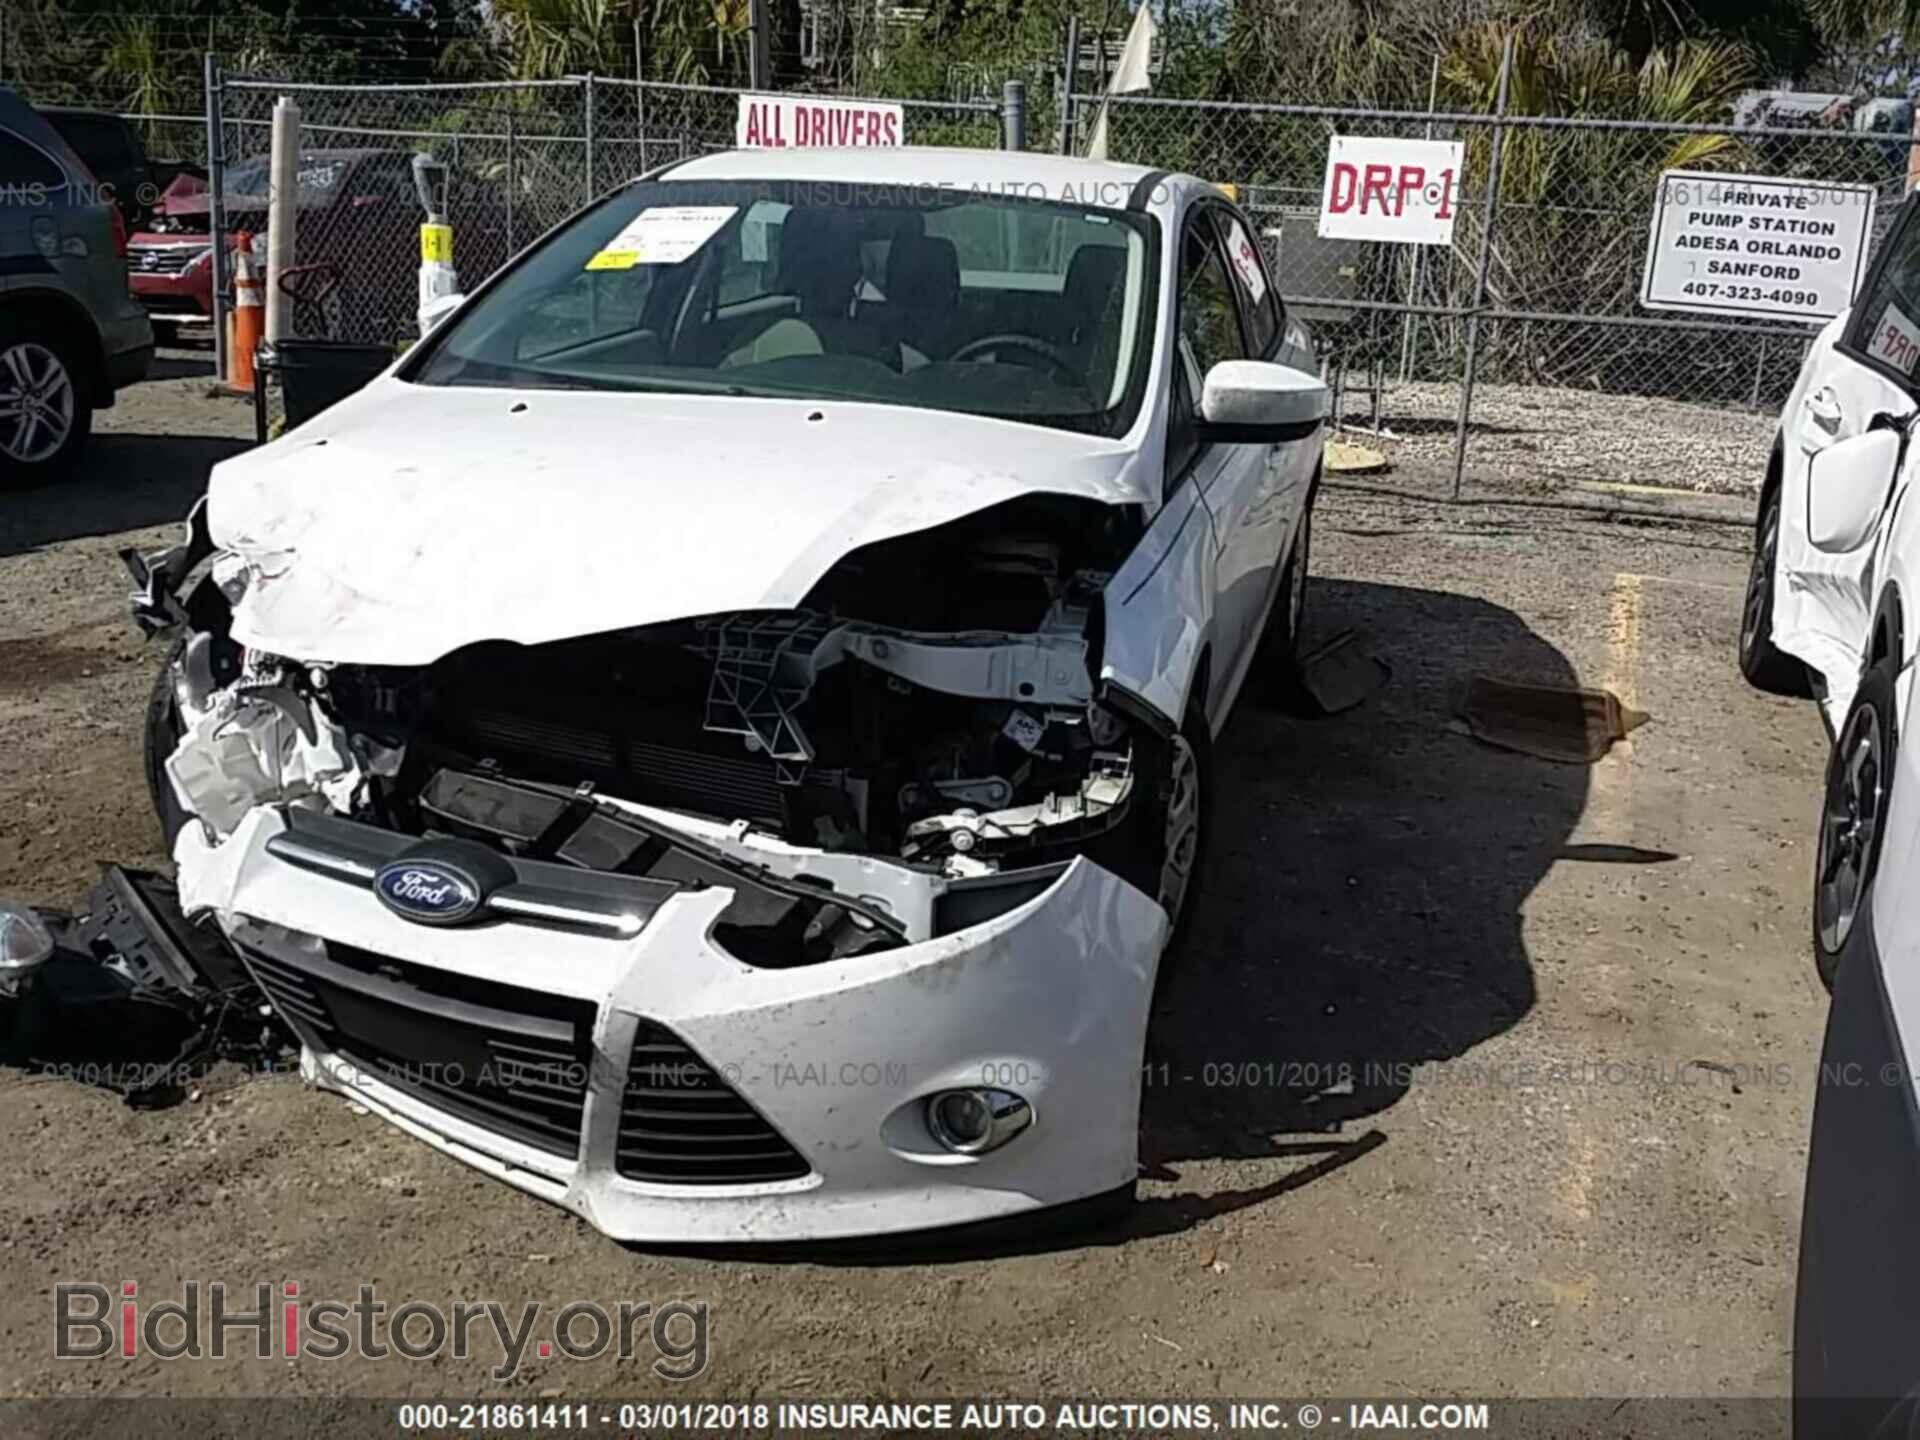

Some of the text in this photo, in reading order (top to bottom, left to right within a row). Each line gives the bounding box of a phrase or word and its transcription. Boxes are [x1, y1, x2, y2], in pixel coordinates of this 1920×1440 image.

[746, 103, 786, 147] ALL
[1723, 190, 1808, 210] PRIVATE
[1688, 211, 1836, 236] PUMP STATION
[1675, 234, 1841, 260] ADESA ORLANDO
[1707, 260, 1801, 281] SANFORD
[1683, 282, 1818, 306] 407-323-4090
[393, 870, 451, 904] Ford
